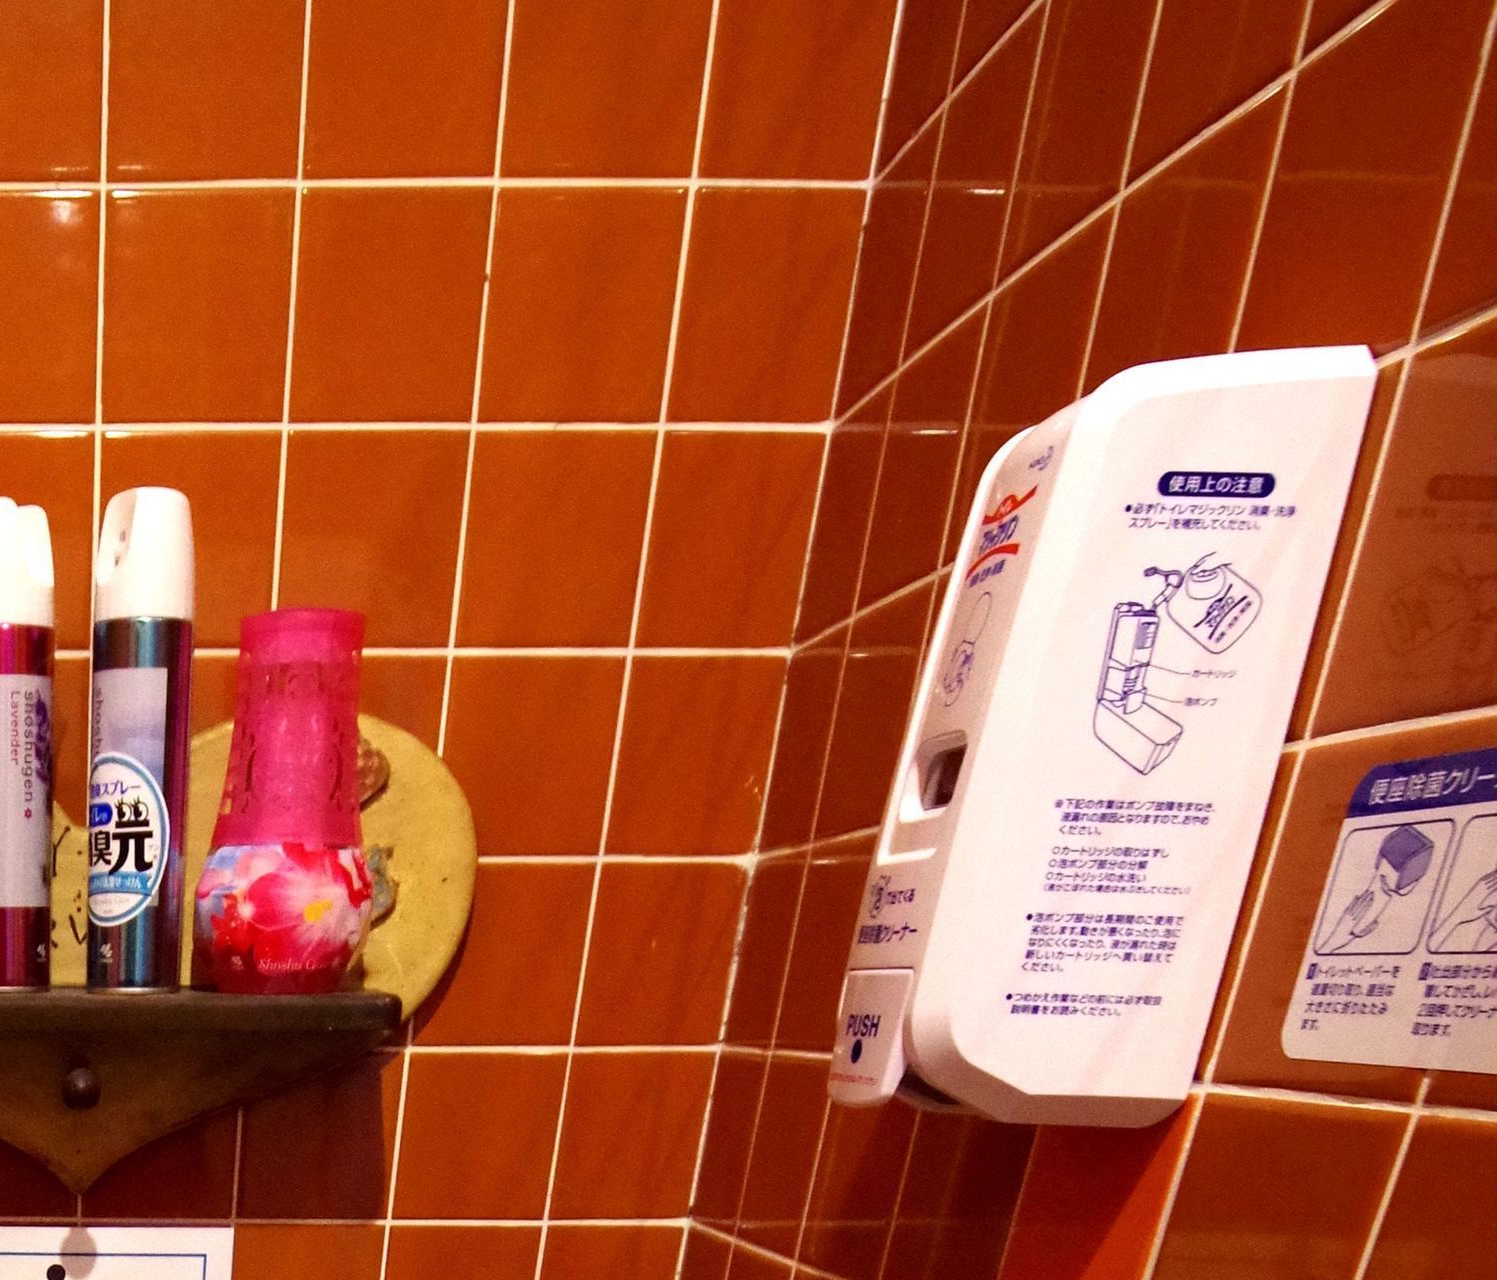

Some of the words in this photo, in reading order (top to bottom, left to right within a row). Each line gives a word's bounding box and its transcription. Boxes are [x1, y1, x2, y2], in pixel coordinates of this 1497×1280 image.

[1168, 475, 1265, 494] 使用上の注意
[10, 691, 21, 765] Lavender
[22, 691, 37, 802] shoshugen
[1368, 766, 1497, 806] 便座除菌クリー
[845, 1015, 881, 1038] PUSH
